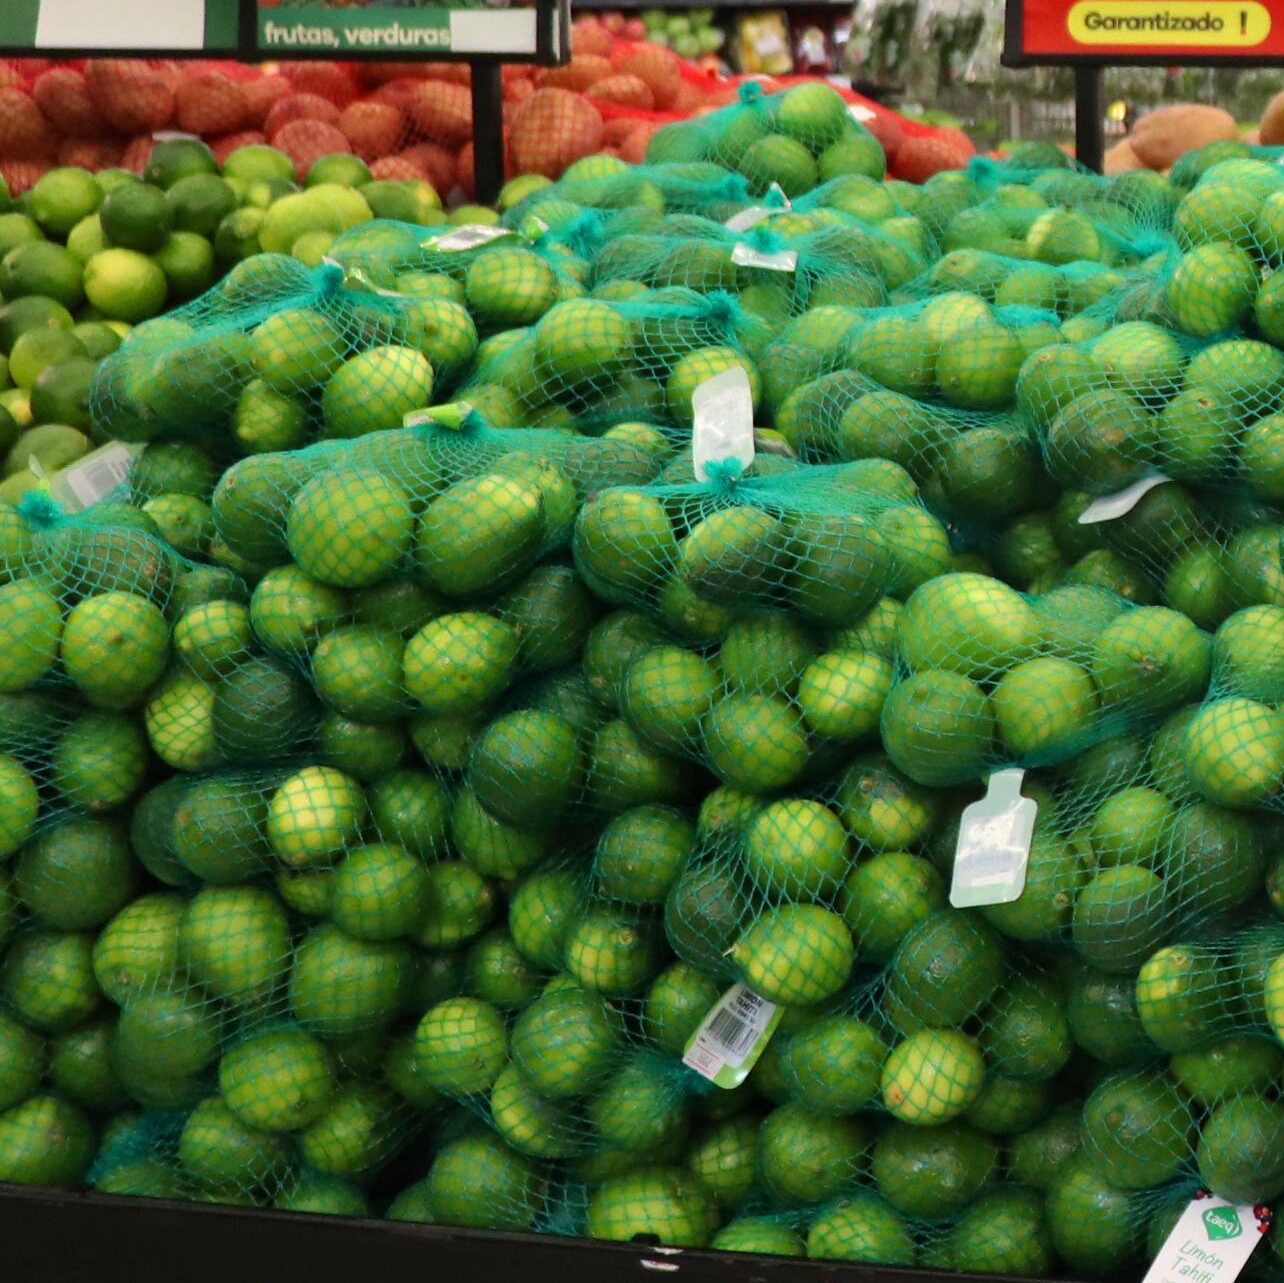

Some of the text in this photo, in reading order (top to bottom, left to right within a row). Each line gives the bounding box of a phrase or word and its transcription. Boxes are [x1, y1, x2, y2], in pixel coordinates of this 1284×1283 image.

[1084, 10, 1225, 32] Garantizado
[264, 21, 450, 48] frutas, verduras
[1205, 1210, 1236, 1235] taeq
[1179, 1239, 1225, 1271] Limón
